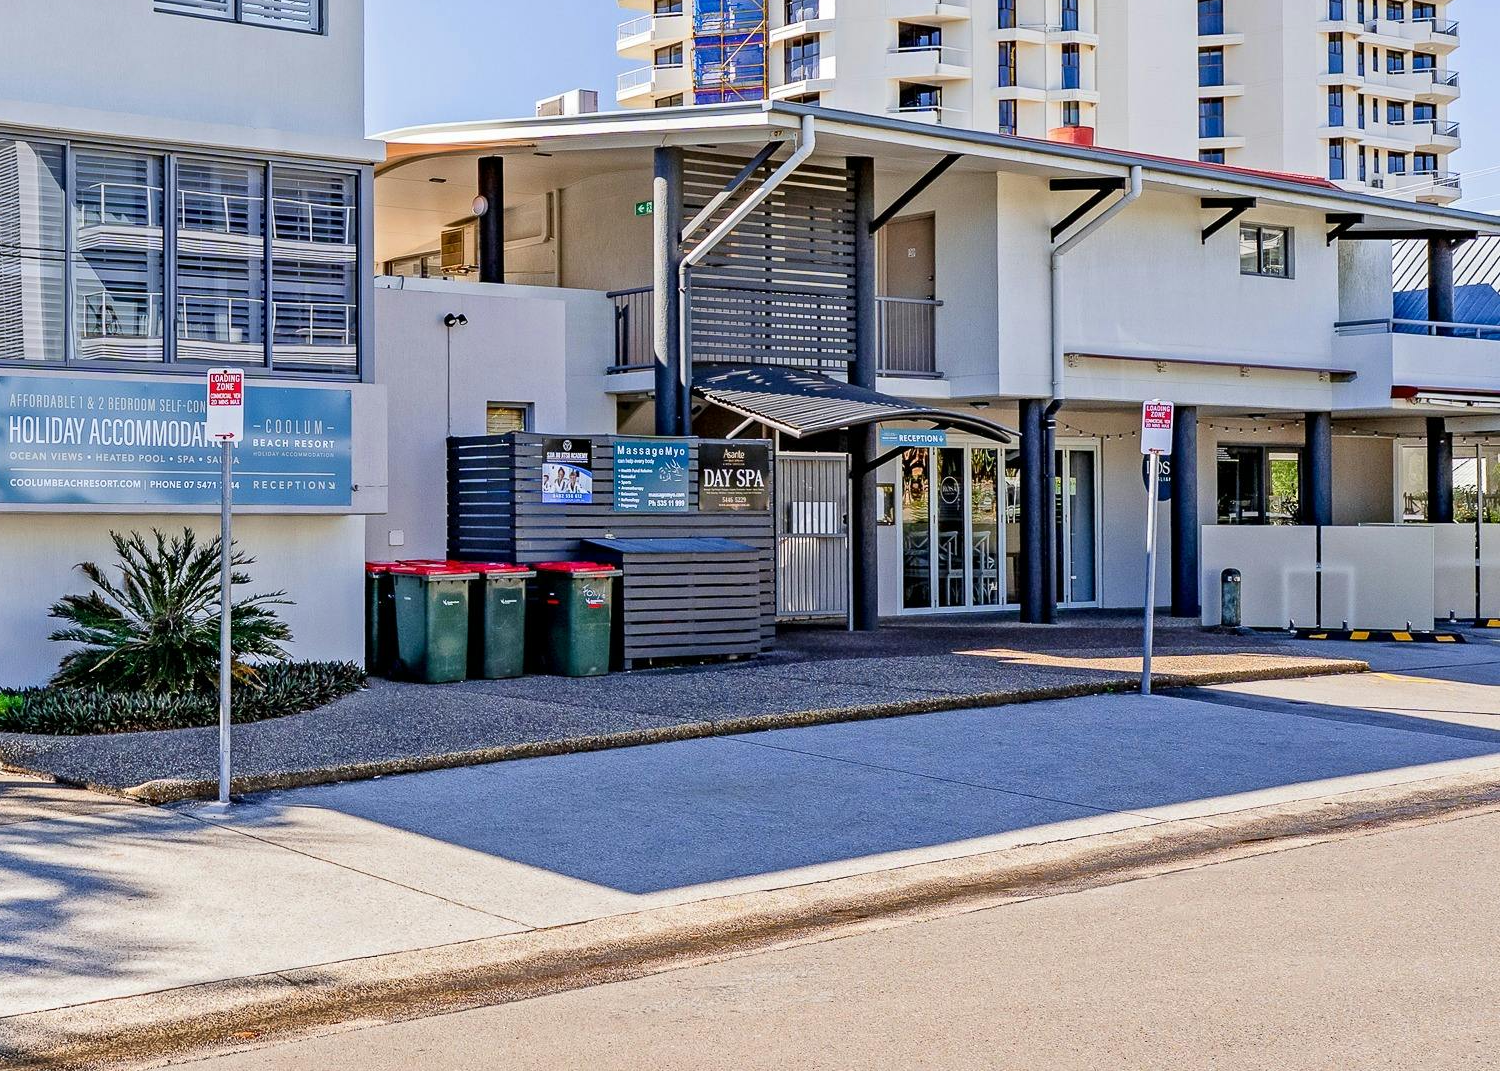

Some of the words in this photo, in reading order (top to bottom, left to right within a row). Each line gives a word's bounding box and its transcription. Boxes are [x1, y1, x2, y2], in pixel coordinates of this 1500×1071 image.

[10, 394, 75, 409] AFFORDABLE
[79, 397, 83, 409] 1
[87, 397, 94, 409] &
[98, 397, 104, 410] 2
[108, 397, 156, 412] BEDROOM
[10, 416, 85, 444] HOLIDAY
[89, 418, 239, 448] ACCOMMODAT
[266, 419, 323, 434] COOLUM
[253, 439, 288, 448] BEACH
[295, 440, 334, 448] RESORT
[617, 446, 685, 457] MassageMyo
[724, 449, 745, 458] Asante
[10, 452, 47, 461] OCEAN
[51, 452, 83, 461] VIEWS
[96, 453, 134, 462] HEATED
[139, 454, 165, 463] POOL
[177, 455, 195, 464] SPA
[207, 456, 240, 464] SAA
[10, 478, 141, 488] COOLUMBEACHRESORT.COM
[150, 480, 181, 489] PHONE
[704, 469, 733, 487] DAY
[736, 469, 764, 487] SPA
[254, 481, 328, 489] RECEPTION
